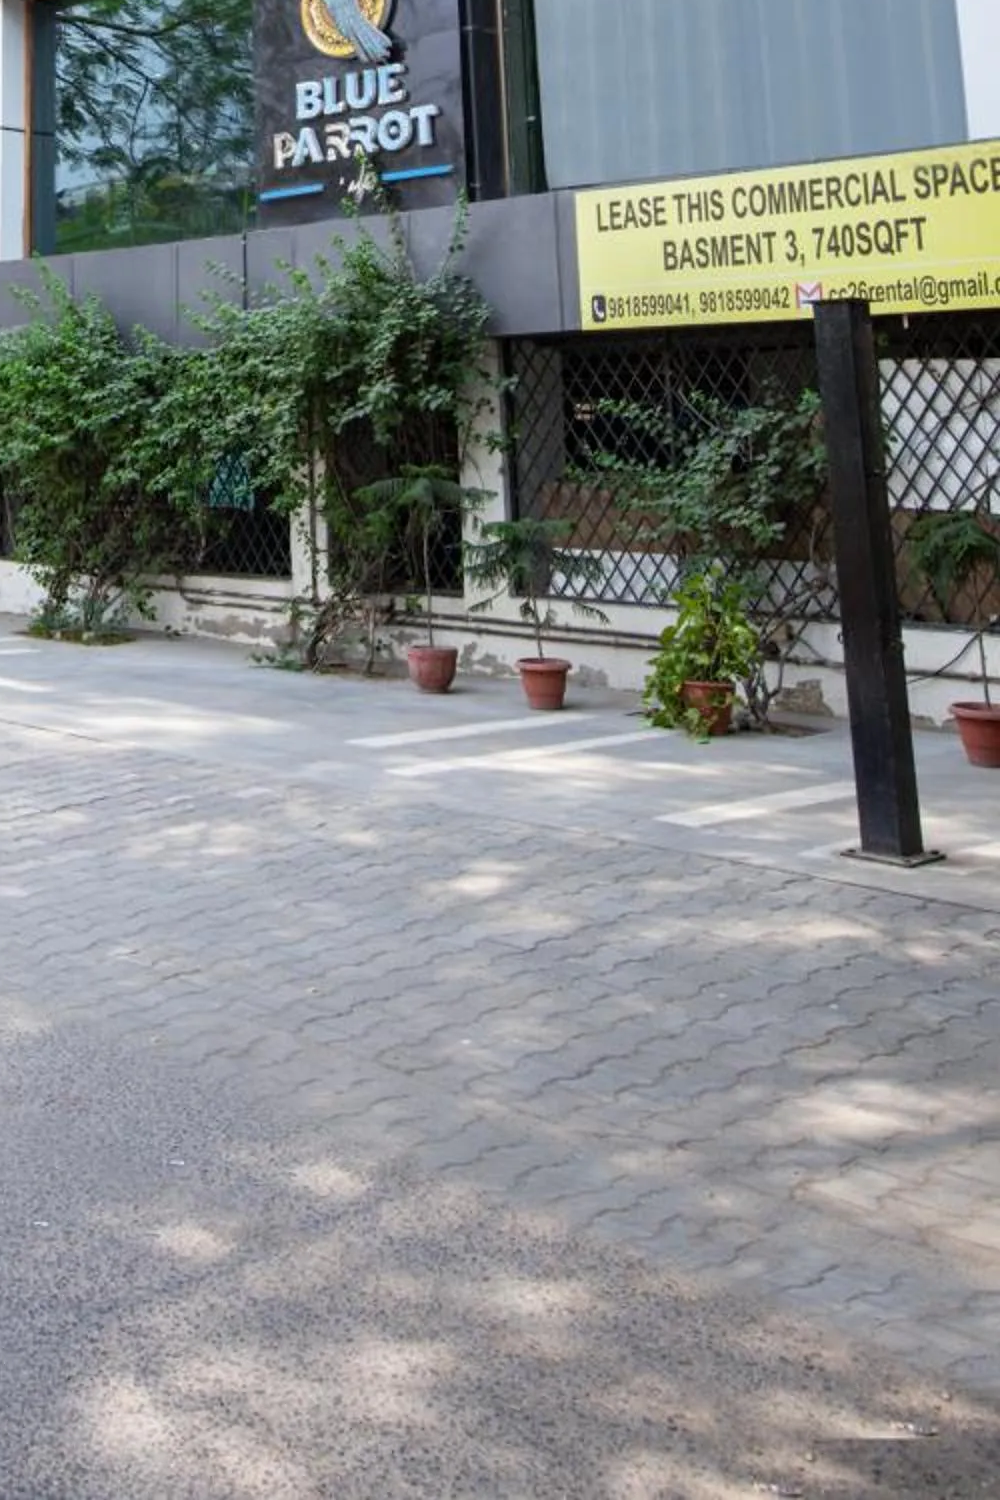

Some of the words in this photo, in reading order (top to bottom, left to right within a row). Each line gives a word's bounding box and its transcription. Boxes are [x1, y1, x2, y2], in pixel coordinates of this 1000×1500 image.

[296, 63, 405, 120] BLUE
[273, 104, 440, 169] PARROT
[596, 196, 668, 232] LEASE
[674, 190, 725, 224] THIS
[732, 168, 906, 218] COMMERCIAL
[913, 157, 1000, 199] SPACE
[663, 232, 777, 271] BASMENT
[811, 216, 927, 260] 740SQFT
[699, 287, 790, 313] 9818599042
